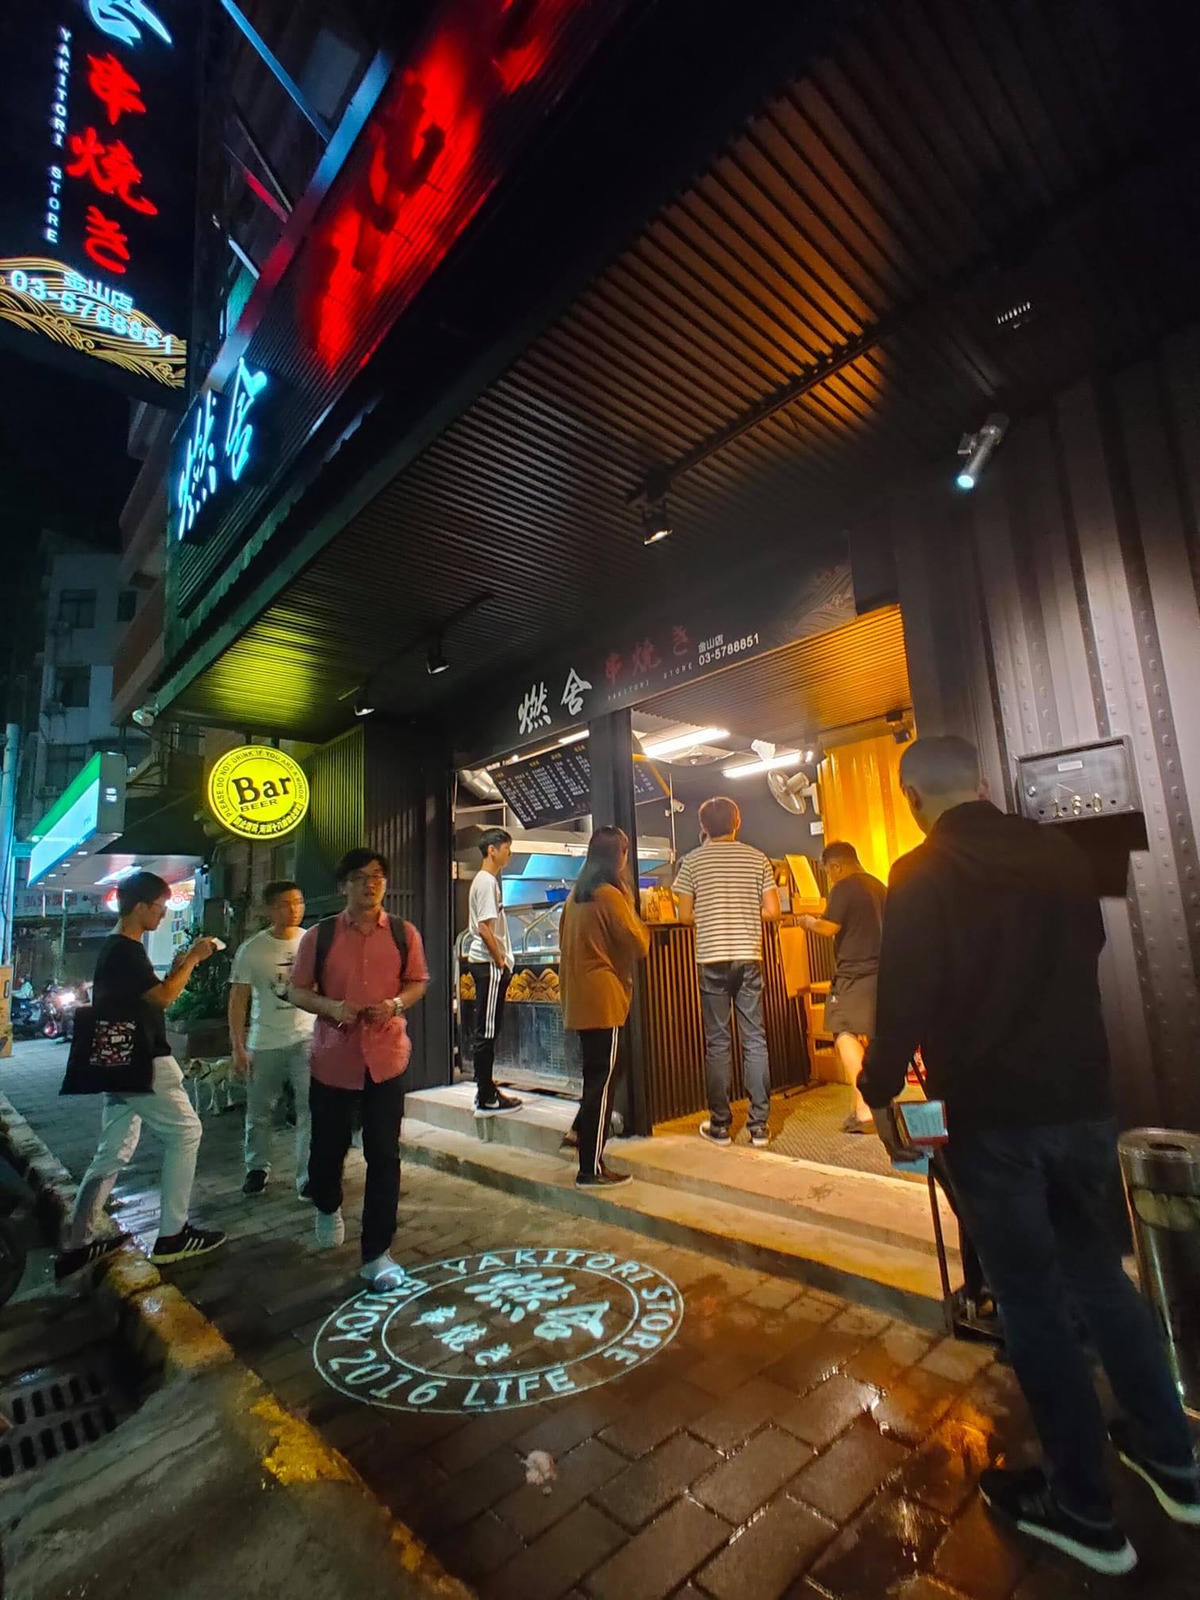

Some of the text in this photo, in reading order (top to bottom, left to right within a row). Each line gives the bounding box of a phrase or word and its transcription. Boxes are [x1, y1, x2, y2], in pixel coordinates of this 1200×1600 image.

[44, 25, 71, 244] YAKITORI STORE
[63, 270, 134, 314] 金山店
[10, 269, 173, 355] 03-5788851
[698, 633, 760, 666] 03-5788851
[220, 763, 232, 776] NOT
[233, 750, 254, 763] DRINK
[266, 750, 281, 760] YOU
[217, 777, 225, 787] DO
[231, 776, 291, 805] Bar
[217, 790, 232, 817] PLEASE
[240, 798, 278, 812] BEER
[442, 1248, 677, 1365] YAKITORI STORE
[328, 1350, 448, 1404] 2016
[463, 1368, 576, 1407] LIFE
